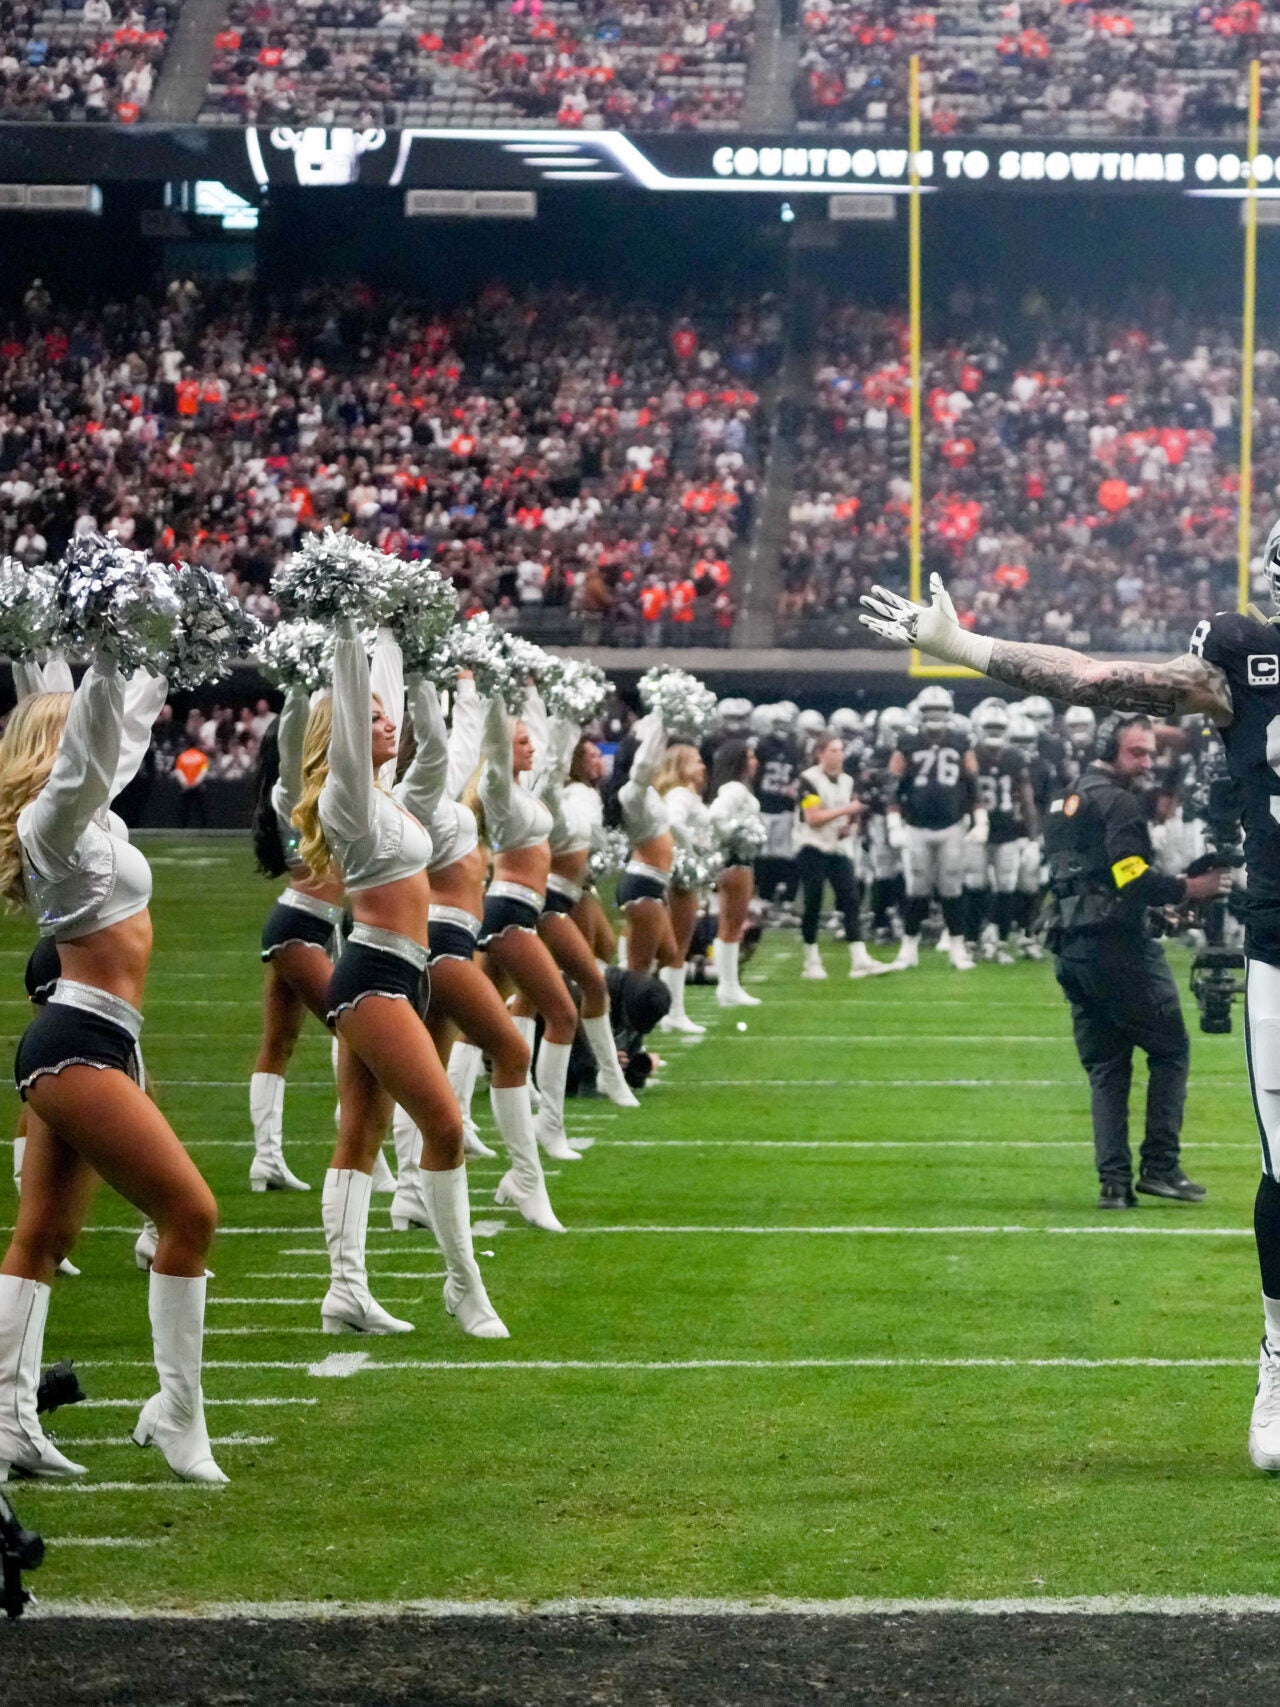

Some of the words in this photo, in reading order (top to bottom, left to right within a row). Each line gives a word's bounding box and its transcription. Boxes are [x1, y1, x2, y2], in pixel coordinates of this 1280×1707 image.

[712, 147, 934, 177] COUNTDOWN
[943, 150, 989, 179] TO
[999, 150, 1184, 181] SHOWTIME
[1250, 657, 1277, 677] C
[911, 747, 960, 787] 76
